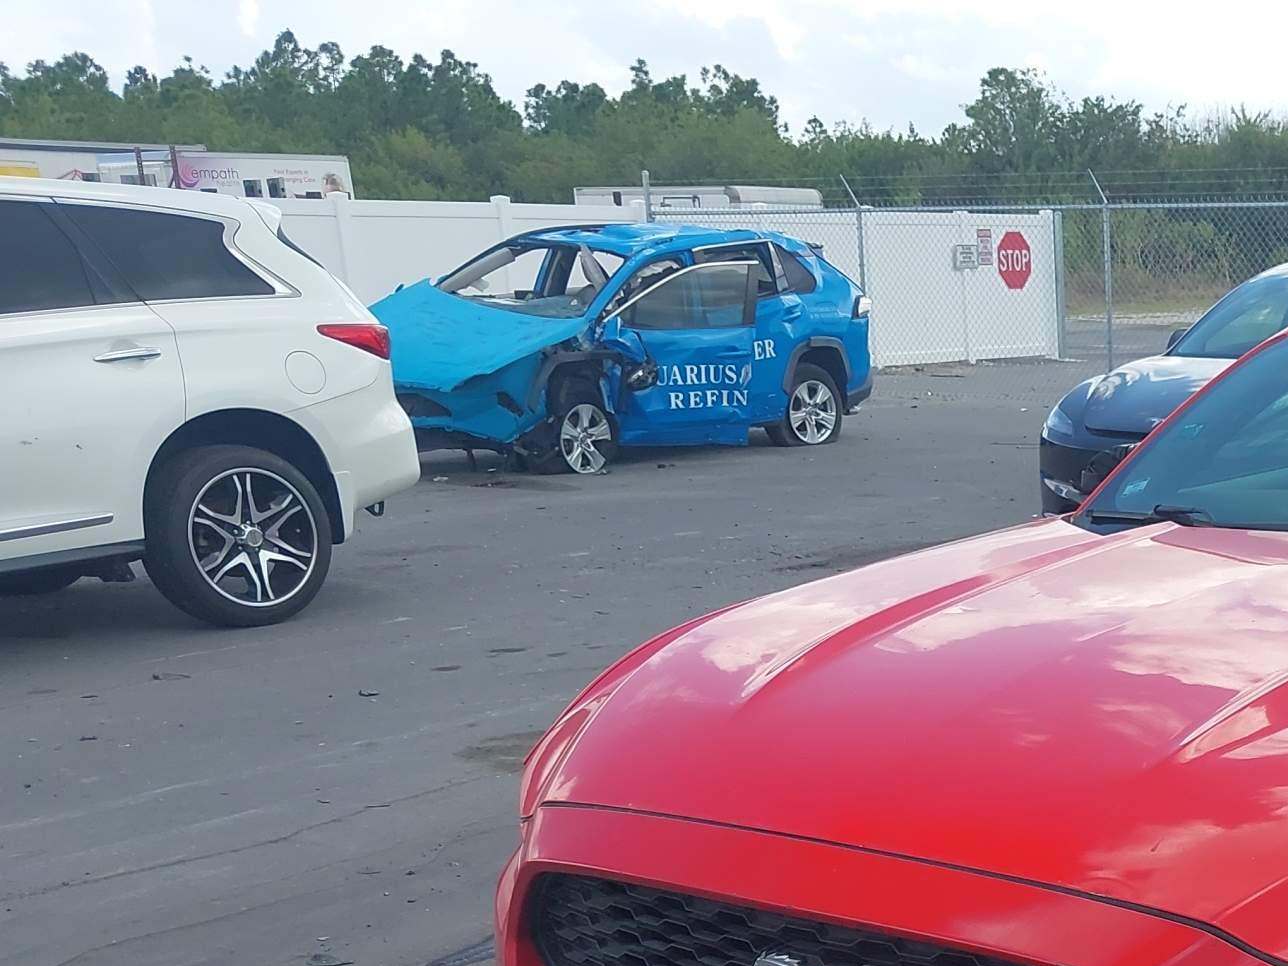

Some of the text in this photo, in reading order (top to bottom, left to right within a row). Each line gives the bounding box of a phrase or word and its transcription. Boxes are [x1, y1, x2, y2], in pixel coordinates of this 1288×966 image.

[191, 167, 240, 180] empath
[999, 249, 1030, 272] STOP
[753, 339, 777, 361] ER
[656, 364, 738, 386] UARIUS
[668, 389, 749, 410] REFIN
